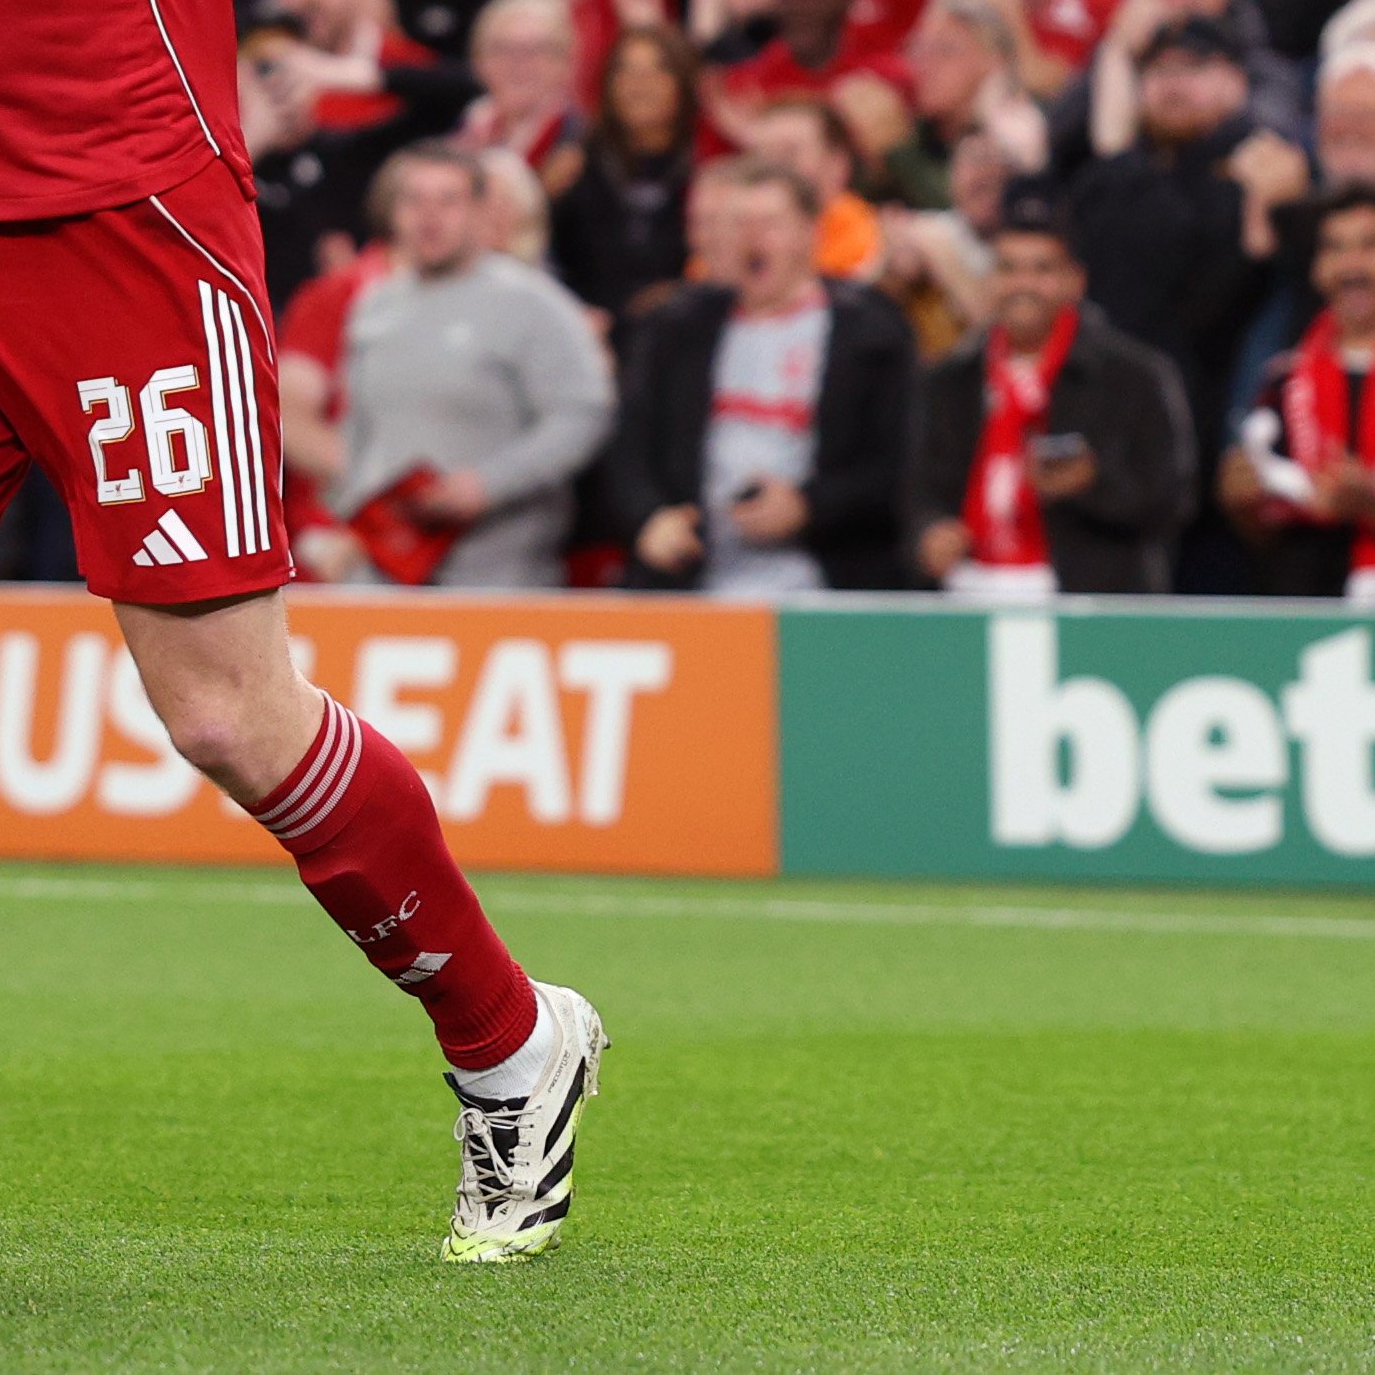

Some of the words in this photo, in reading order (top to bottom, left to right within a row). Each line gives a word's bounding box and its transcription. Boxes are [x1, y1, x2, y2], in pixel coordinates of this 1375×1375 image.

[76, 364, 213, 506] 26
[350, 634, 674, 825] EAT
[988, 613, 1375, 857] bet
[346, 890, 421, 943] LFC
